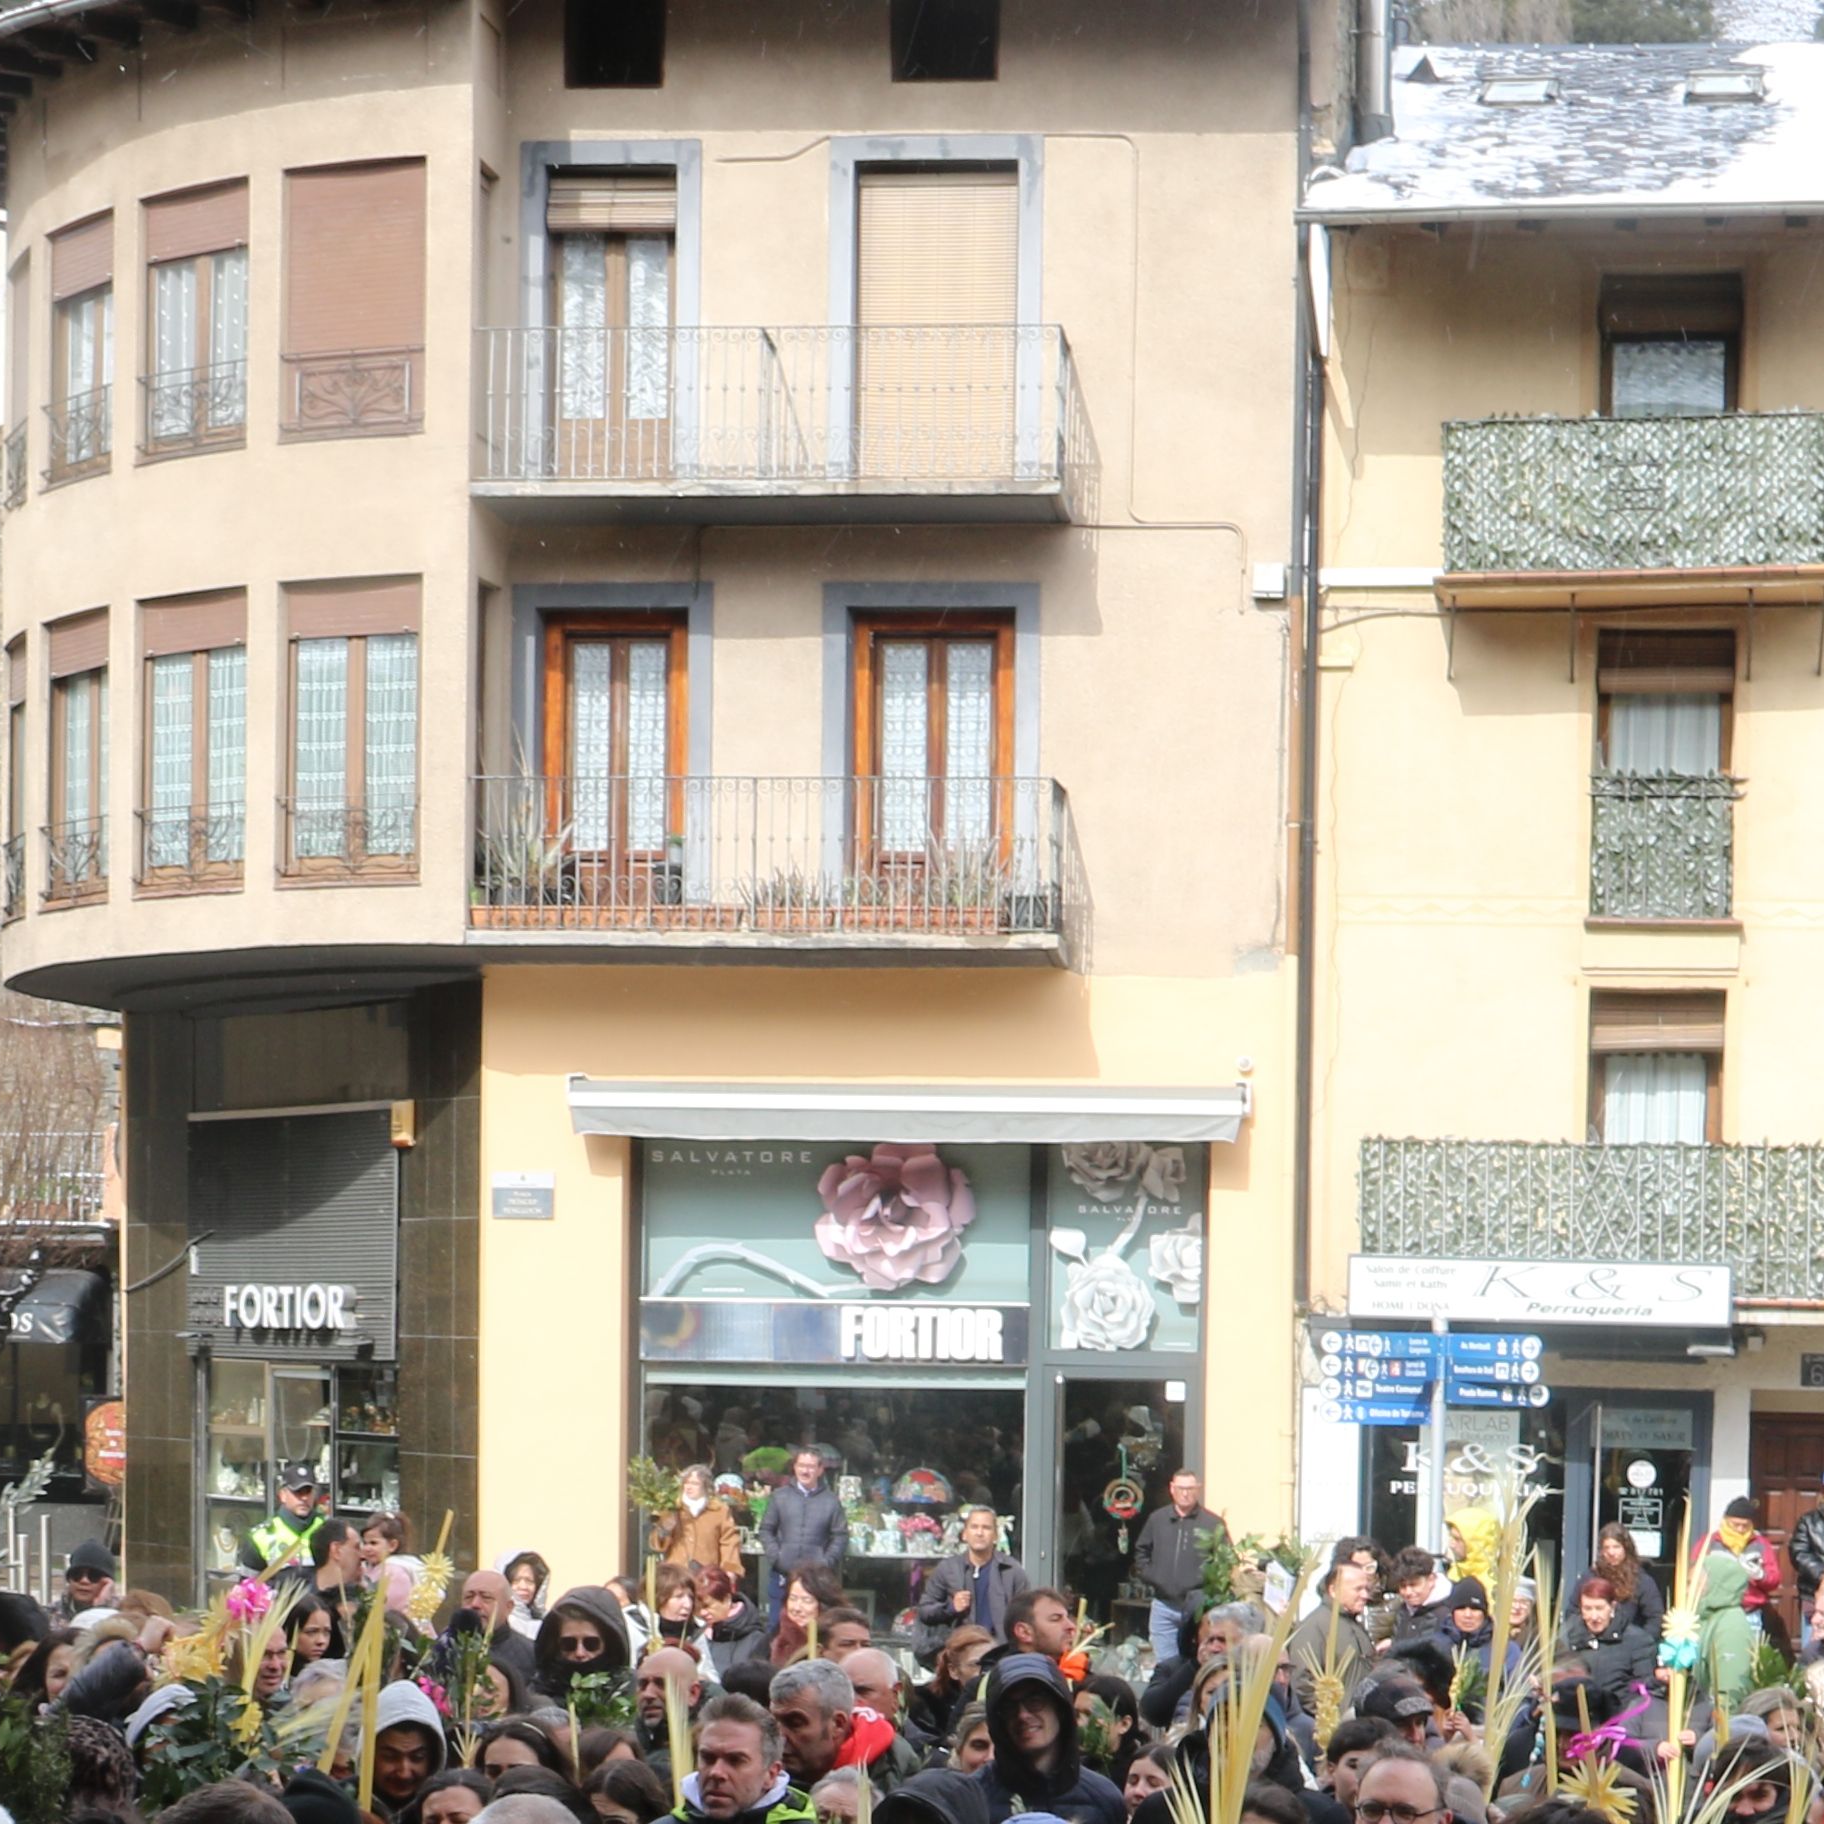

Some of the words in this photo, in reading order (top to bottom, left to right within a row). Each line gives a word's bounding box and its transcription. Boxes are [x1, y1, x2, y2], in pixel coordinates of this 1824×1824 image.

[651, 1150, 812, 1163] SALVATORE
[1078, 1204, 1182, 1215] SALVAORE
[1473, 1264, 1545, 1299] K
[1566, 1267, 1628, 1301] &
[1657, 1269, 1712, 1302] S
[224, 1284, 344, 1329] FORTIOR
[840, 1305, 1004, 1361] FORTIOR
[1811, 1364, 1824, 1385] 6
[1450, 1443, 1495, 1473] &
[1505, 1444, 1539, 1474] S
